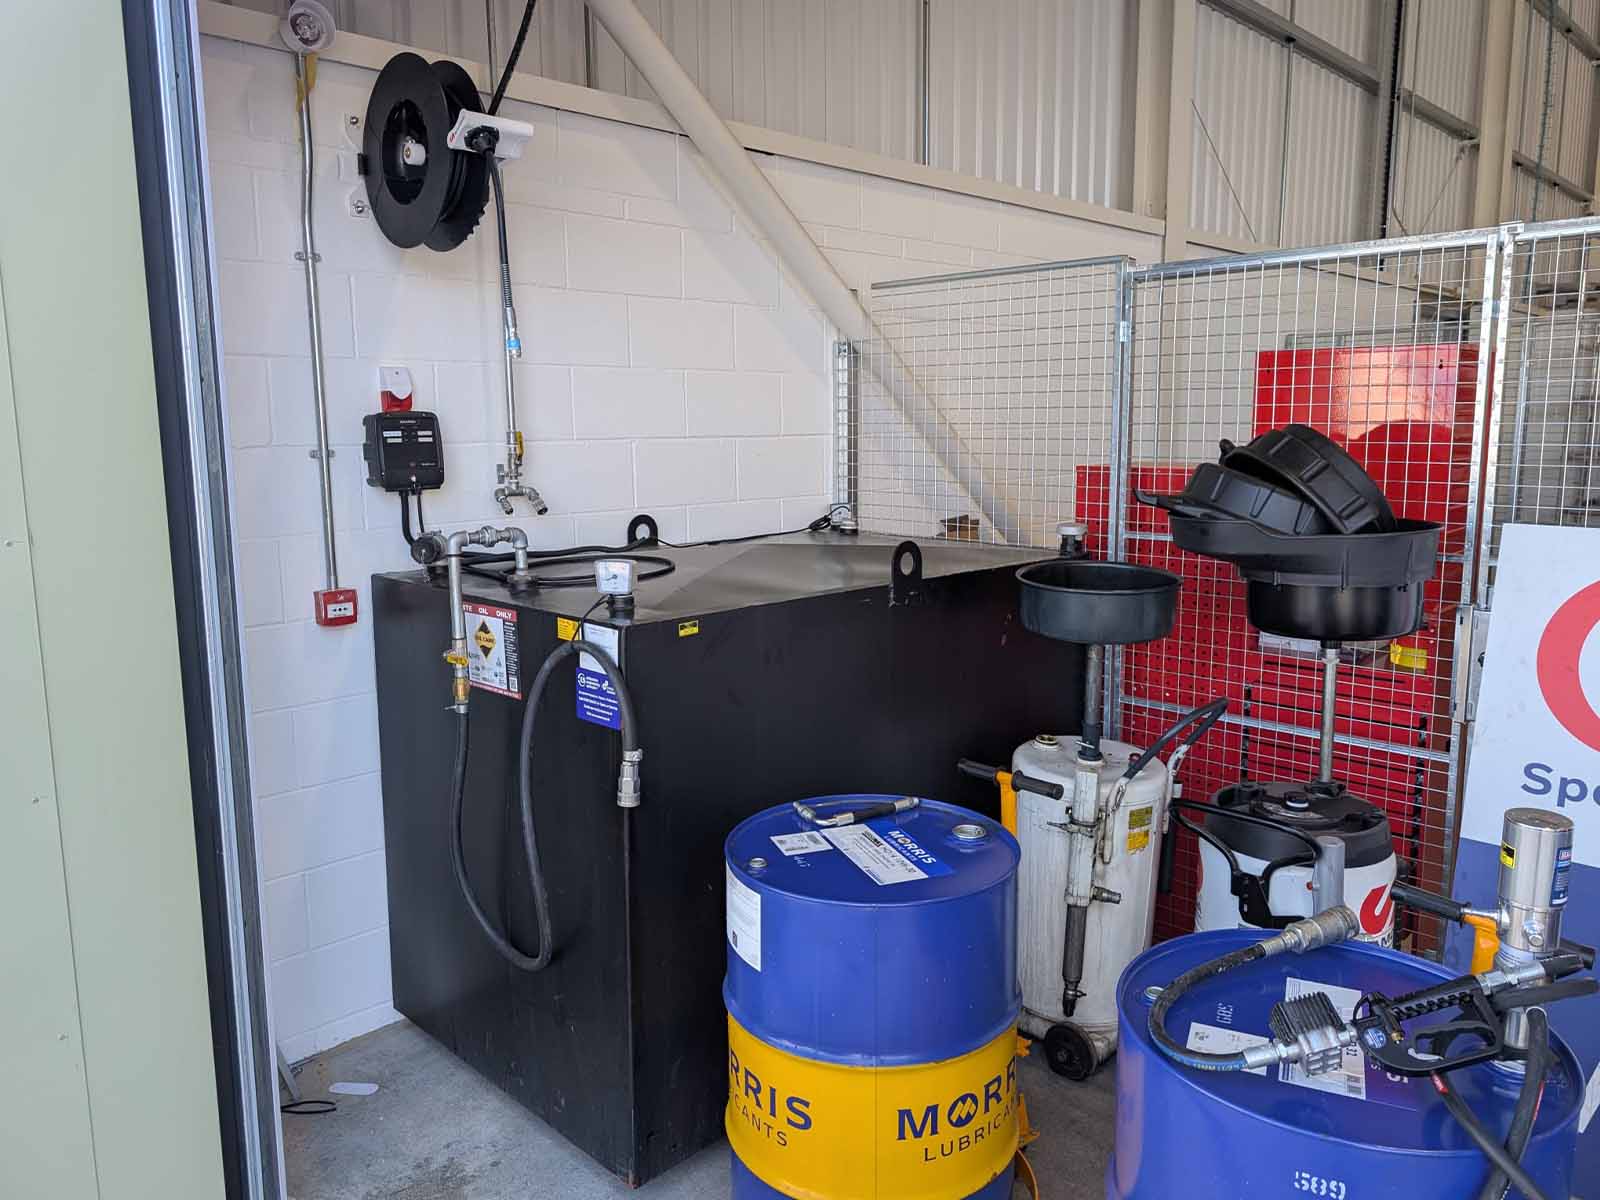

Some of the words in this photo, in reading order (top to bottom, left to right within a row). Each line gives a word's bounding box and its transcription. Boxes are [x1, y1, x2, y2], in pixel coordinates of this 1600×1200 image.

[478, 607, 489, 615] OIL
[495, 610, 512, 620] ONLY
[1521, 762, 1600, 807] Sp
[888, 830, 937, 864] MORRIS
[730, 1047, 812, 1131] RRIS
[895, 1055, 1016, 1141] MORR
[734, 1092, 788, 1147] CANTS
[1294, 1170, 1347, 1200] 589
